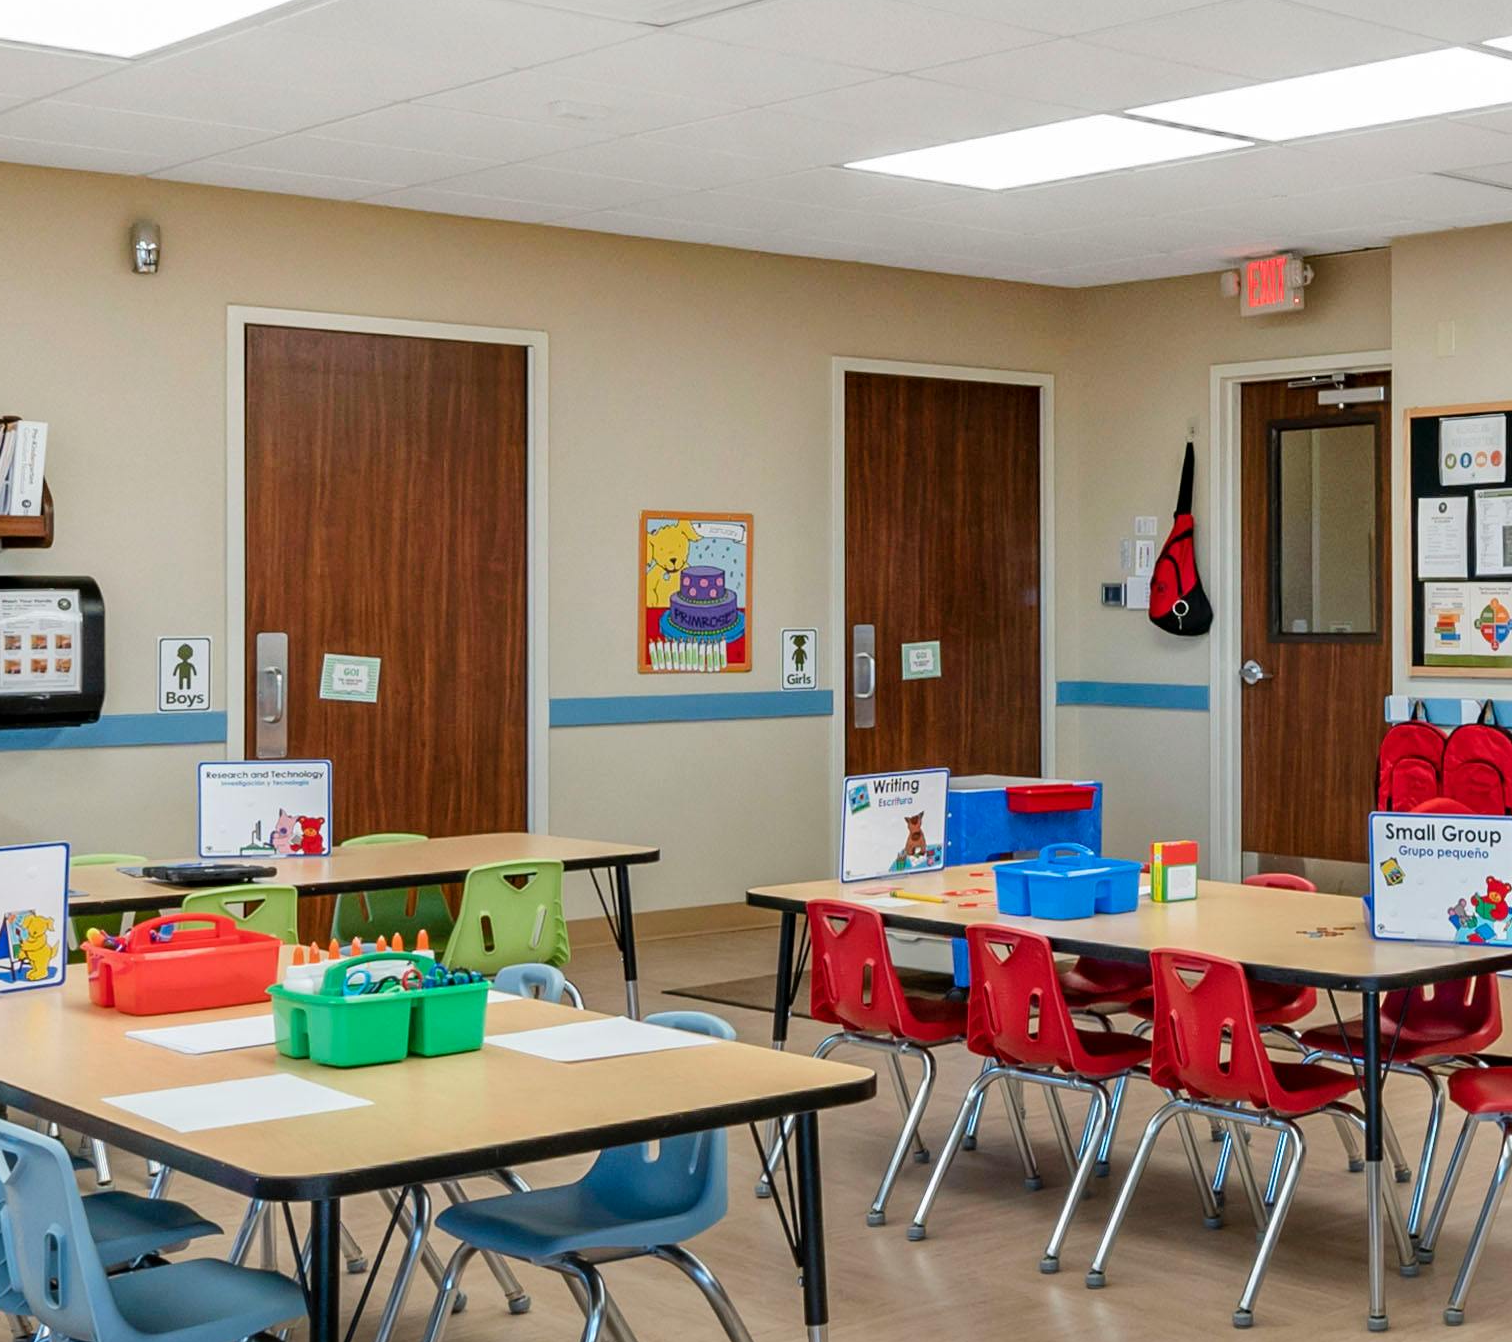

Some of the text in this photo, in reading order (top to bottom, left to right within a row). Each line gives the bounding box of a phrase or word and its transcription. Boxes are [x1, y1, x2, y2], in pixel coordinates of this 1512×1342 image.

[1247, 255, 1287, 307] EXIT
[787, 674, 812, 685] Girls
[166, 691, 204, 707] Boys
[206, 770, 325, 779] Research and Technology
[873, 778, 920, 794] Writing
[878, 797, 913, 808] Escritura
[1385, 823, 1502, 847] Small Group
[1398, 845, 1489, 860] Grupo pequeño
